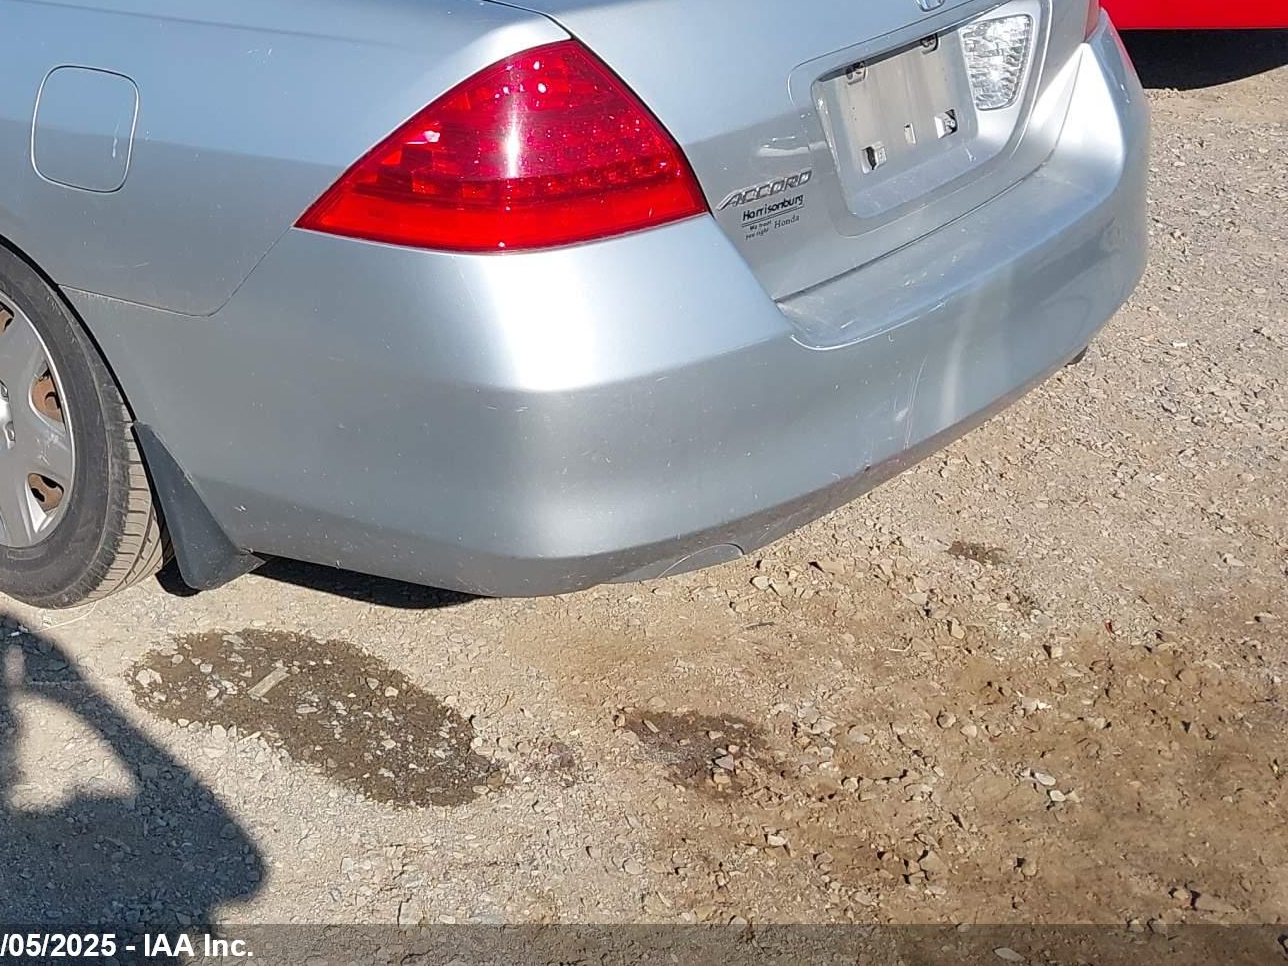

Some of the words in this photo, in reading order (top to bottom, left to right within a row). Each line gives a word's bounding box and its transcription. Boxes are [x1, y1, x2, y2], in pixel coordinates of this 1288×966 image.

[715, 167, 813, 212] ACCORD
[741, 193, 804, 222] Harrisonburg
[773, 214, 801, 230] Honda
